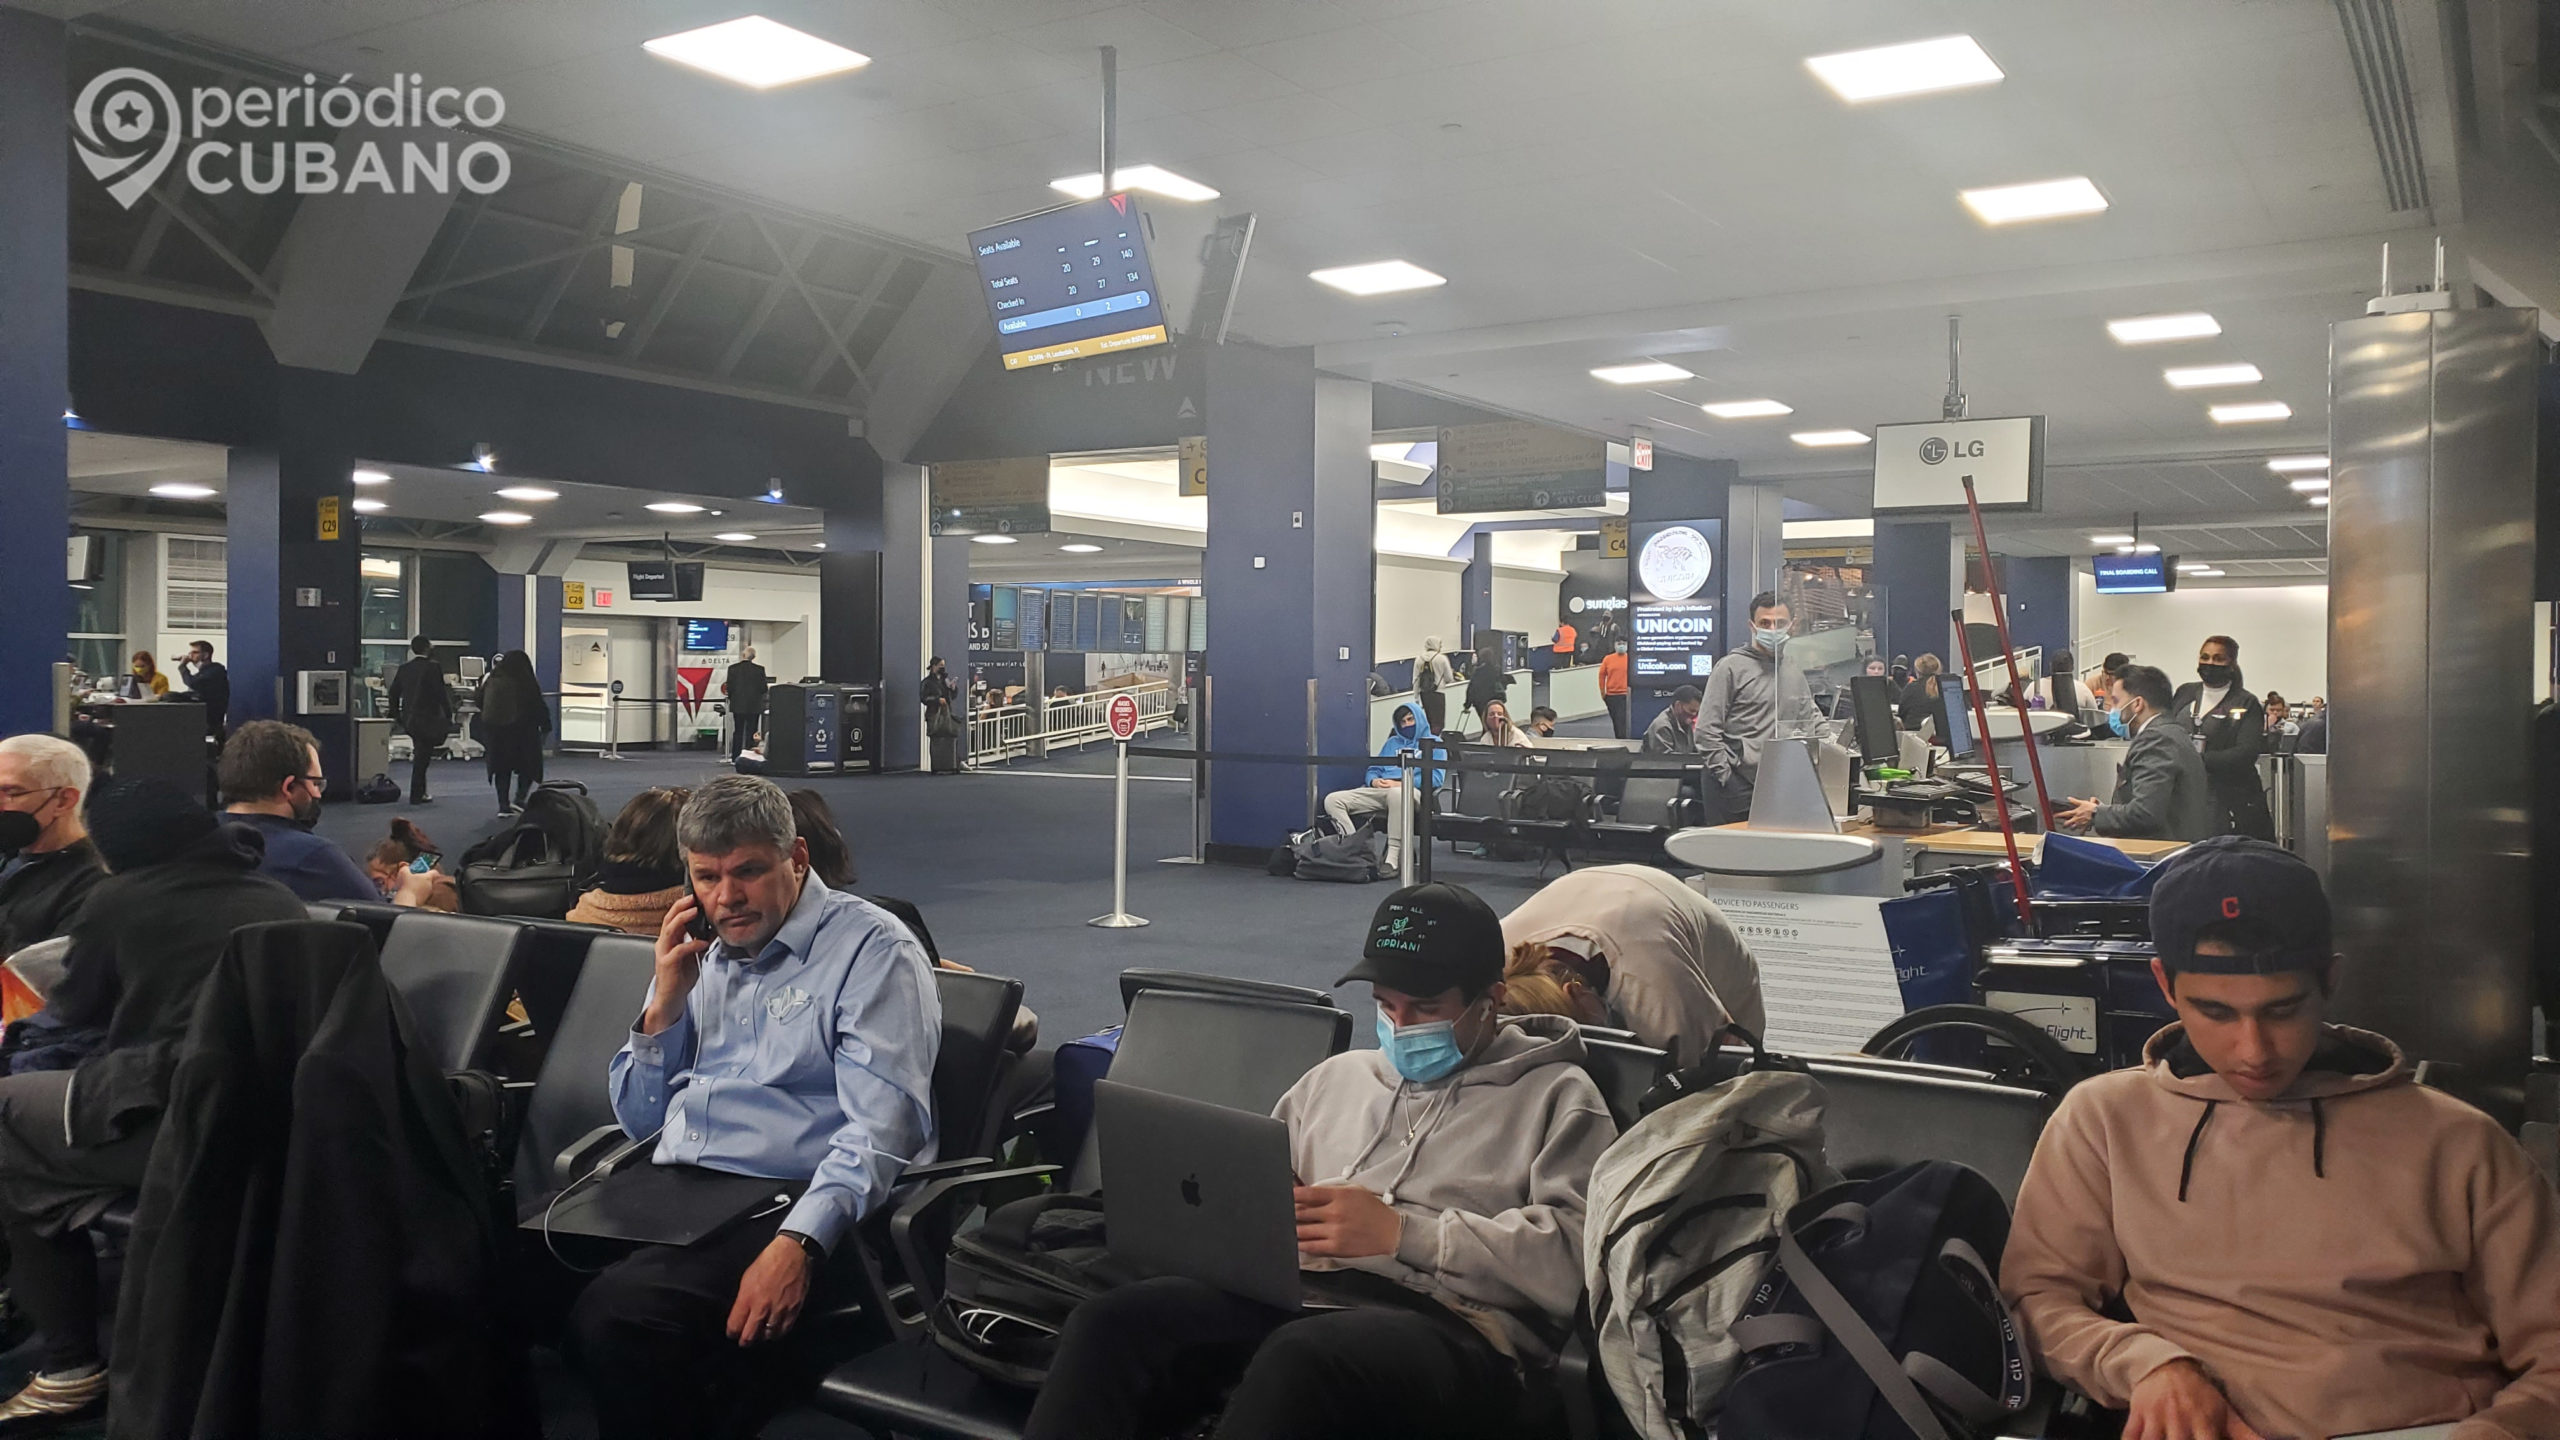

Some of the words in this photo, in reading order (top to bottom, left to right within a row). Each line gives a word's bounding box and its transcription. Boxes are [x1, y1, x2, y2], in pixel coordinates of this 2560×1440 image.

[978, 244, 995, 256] Seats
[995, 238, 1021, 252] Available
[1062, 263, 1072, 273] 20
[1121, 248, 1134, 259] 140
[990, 279, 1004, 289] Total
[1004, 276, 1019, 287] Seats
[1067, 285, 1077, 295] 20
[1126, 271, 1139, 282] 134
[997, 299, 1018, 310] Checked
[1018, 298, 1025, 306] In
[1003, 319, 1027, 331] Available
[1953, 440, 1985, 458] LG
[1577, 494, 1600, 503] CLUB
[322, 520, 337, 532] C29
[1586, 596, 1629, 611] sunglas
[1636, 617, 1713, 634] UNICOIN
[1410, 906, 1424, 914] ALL
[1712, 898, 1740, 907] ADVICE
[1742, 900, 1751, 908] TO
[1753, 901, 1799, 910] PASSENGERS
[2221, 896, 2240, 918] C
[1376, 938, 1421, 952] CIPRIANI
[1755, 1284, 1772, 1304] citi
[2002, 1318, 2014, 1342] citi
[2009, 1358, 2023, 1381] citi
